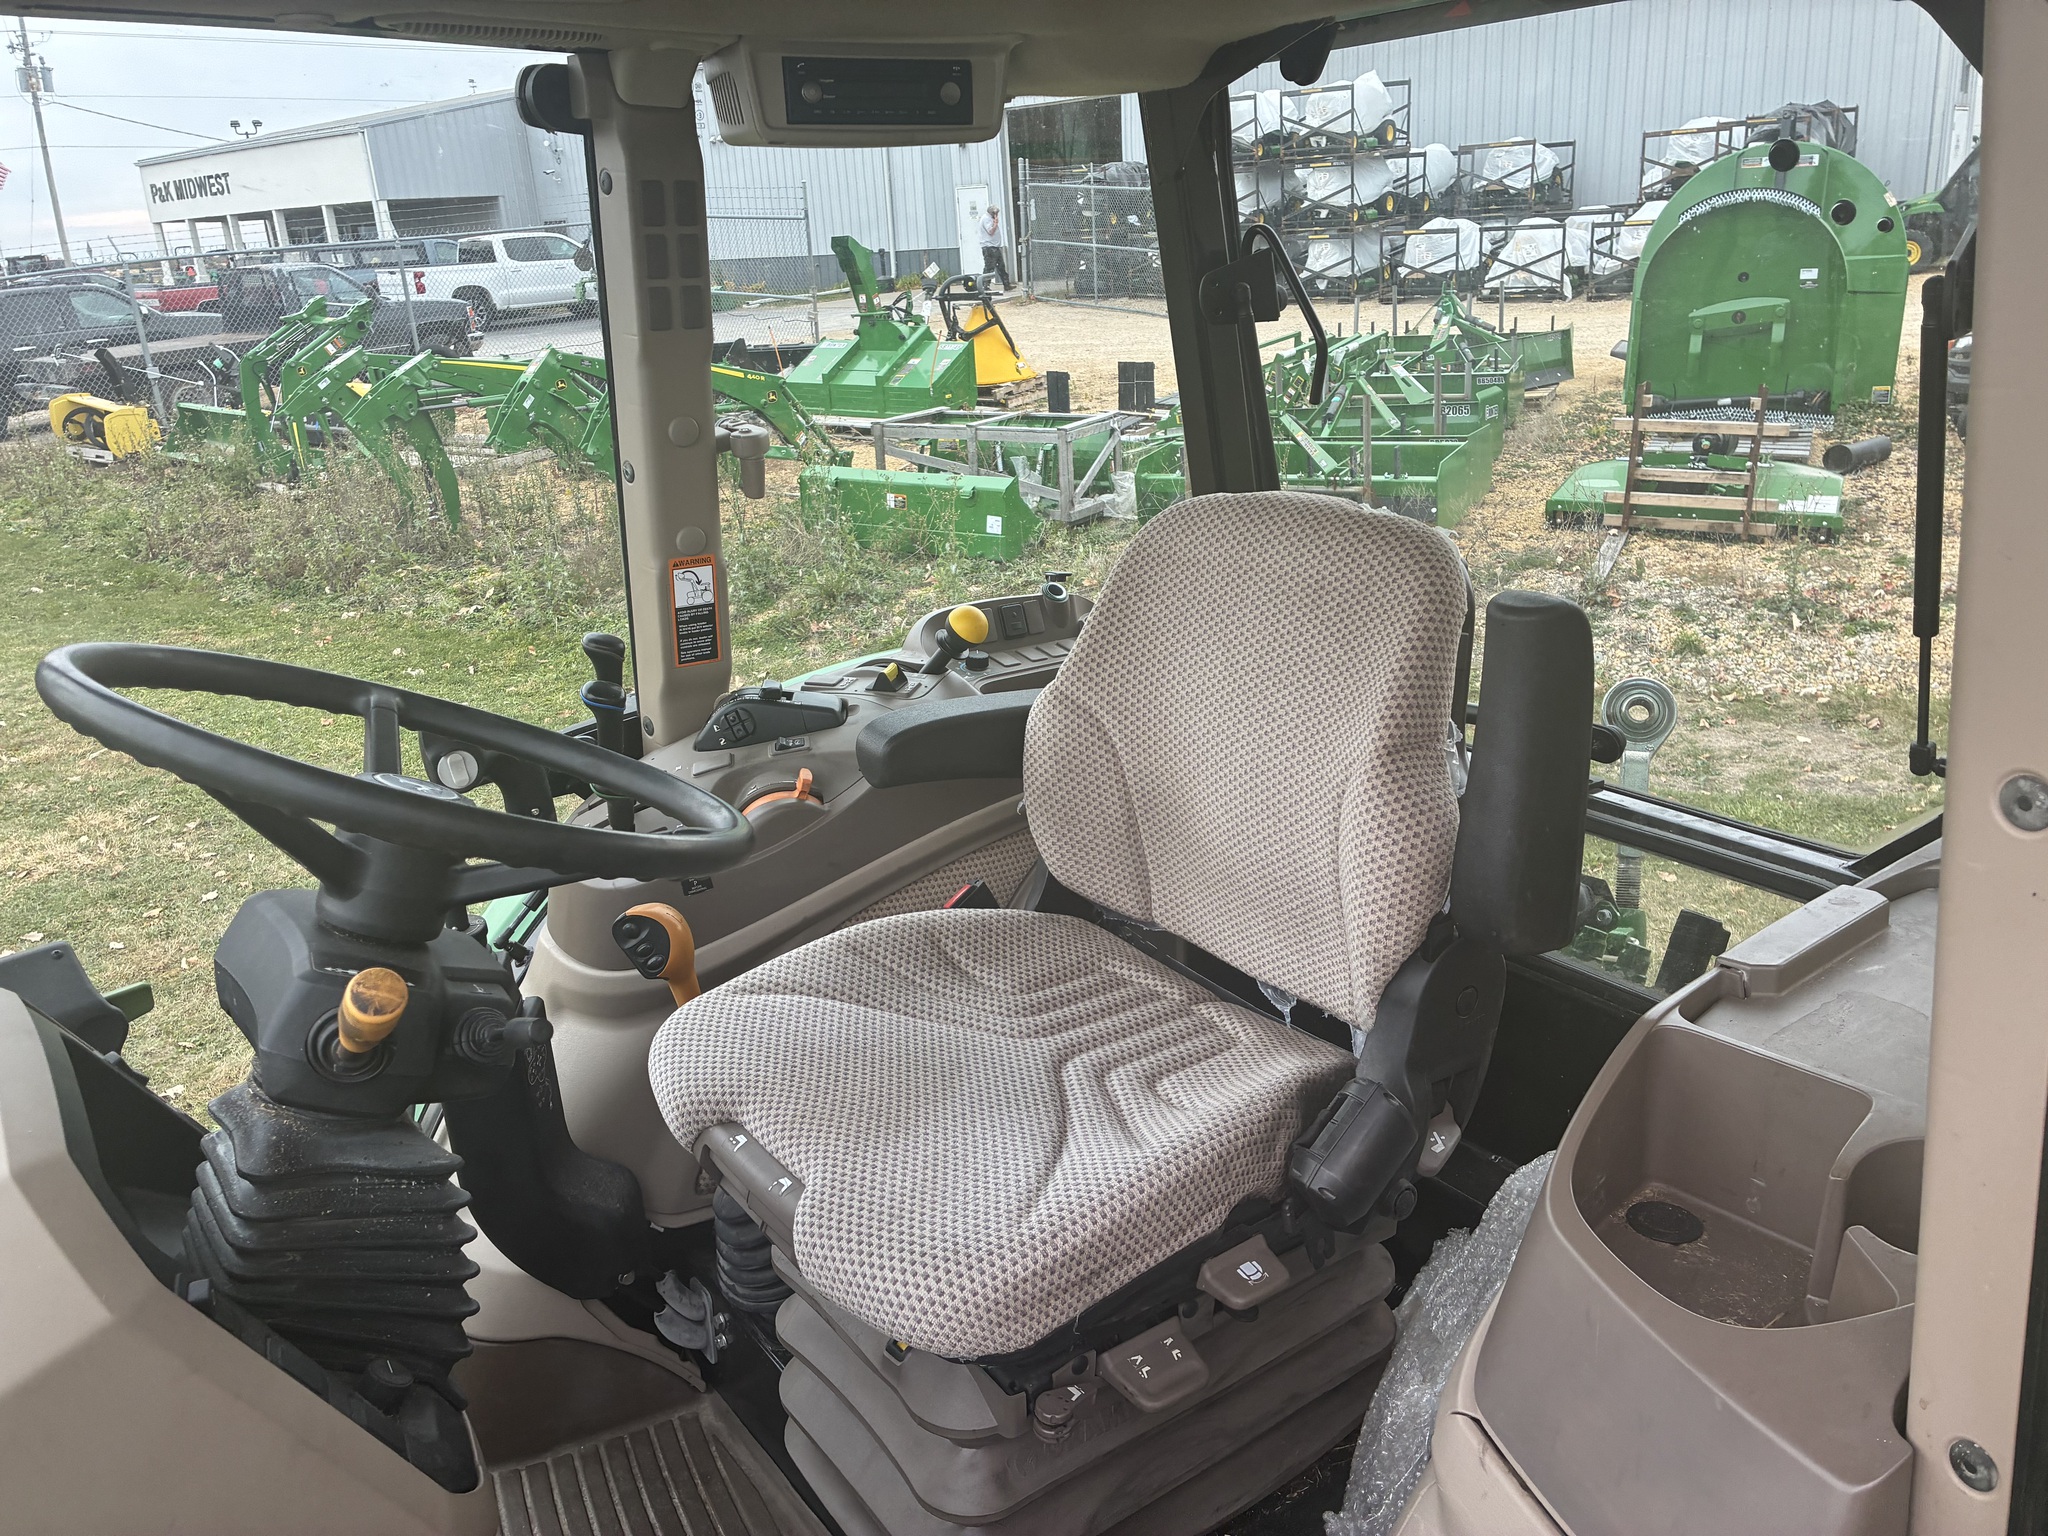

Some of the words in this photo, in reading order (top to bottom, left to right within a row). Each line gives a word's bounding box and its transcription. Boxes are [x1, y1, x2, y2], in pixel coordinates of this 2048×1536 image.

[149, 180, 174, 204] P&K
[173, 172, 231, 201] MIDWEST
[678, 557, 712, 566] WARNING
